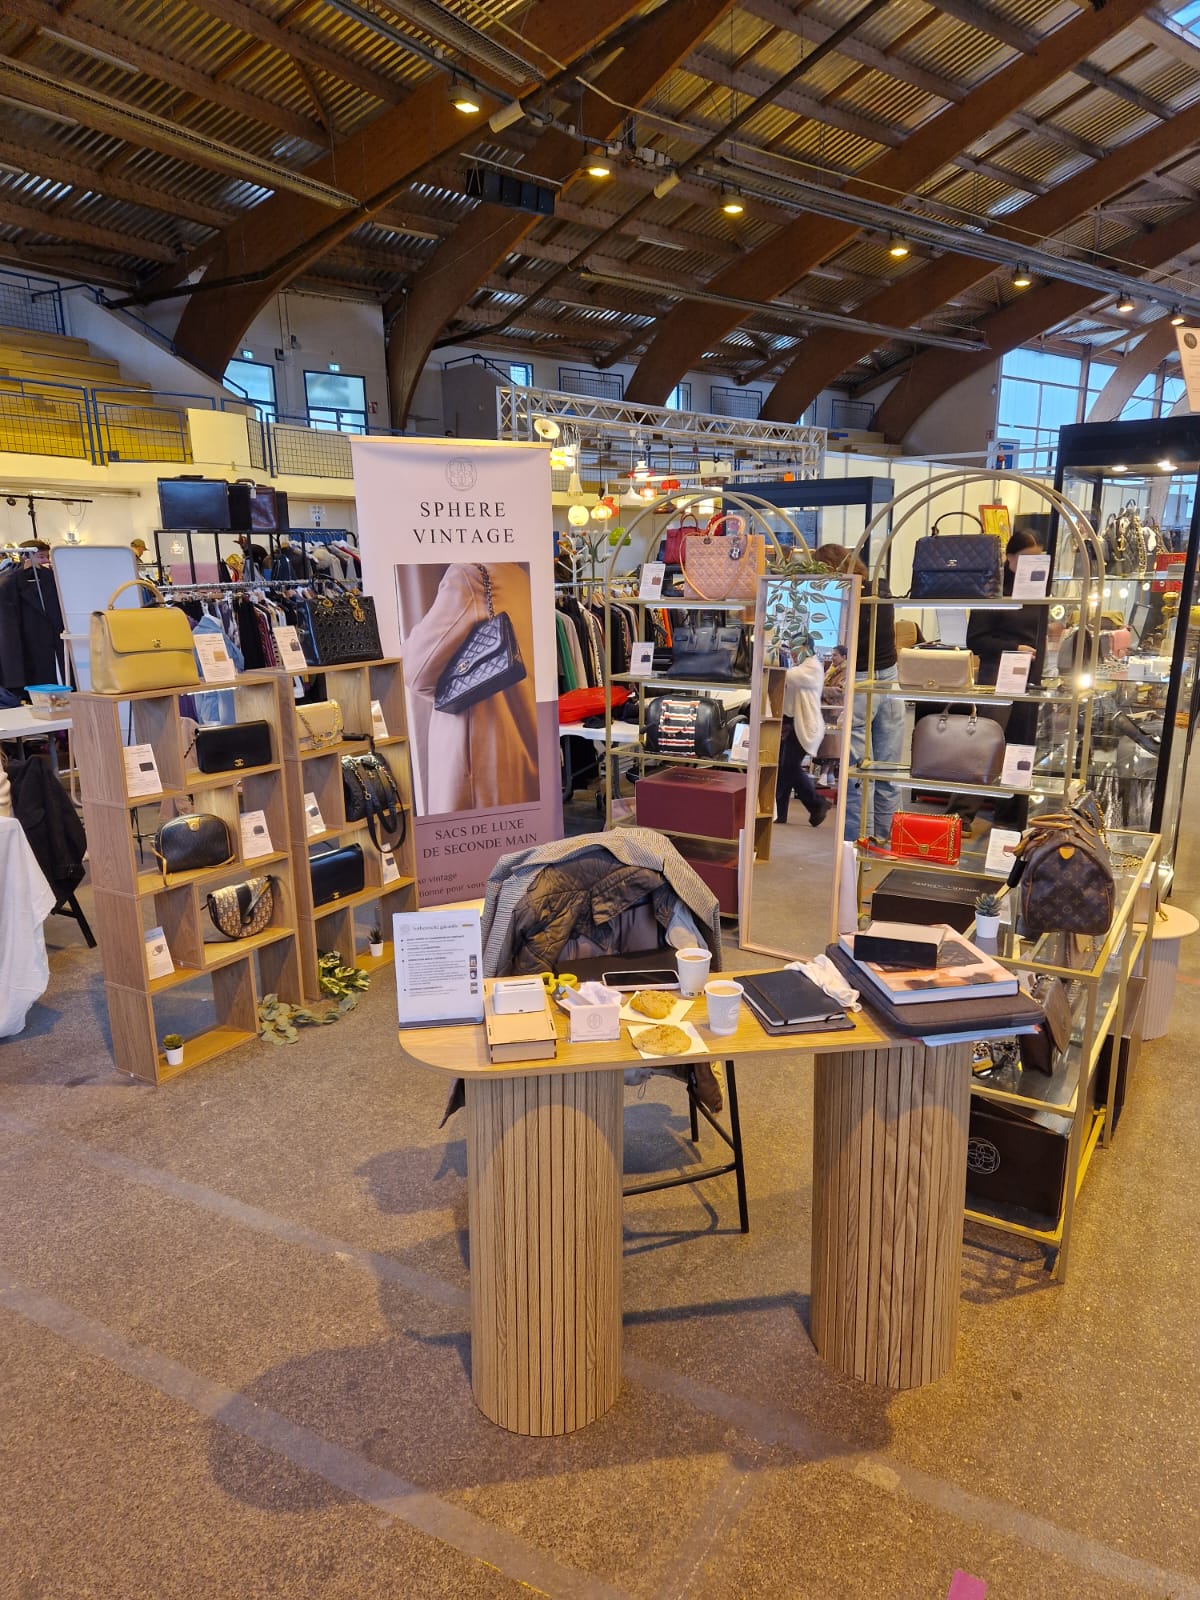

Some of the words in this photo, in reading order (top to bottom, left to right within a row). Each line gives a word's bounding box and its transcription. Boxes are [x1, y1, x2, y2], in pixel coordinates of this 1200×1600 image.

[420, 501, 507, 518] SPHERE
[412, 528, 515, 544] VINTAGE
[435, 826, 467, 841] SACS
[471, 823, 488, 834] DE
[492, 818, 525, 833] LUXE
[423, 846, 440, 859] DE
[444, 839, 502, 856] SECONDE
[505, 833, 537, 847] MAIN
[428, 873, 457, 884] vintage
[446, 883, 465, 895] pour
